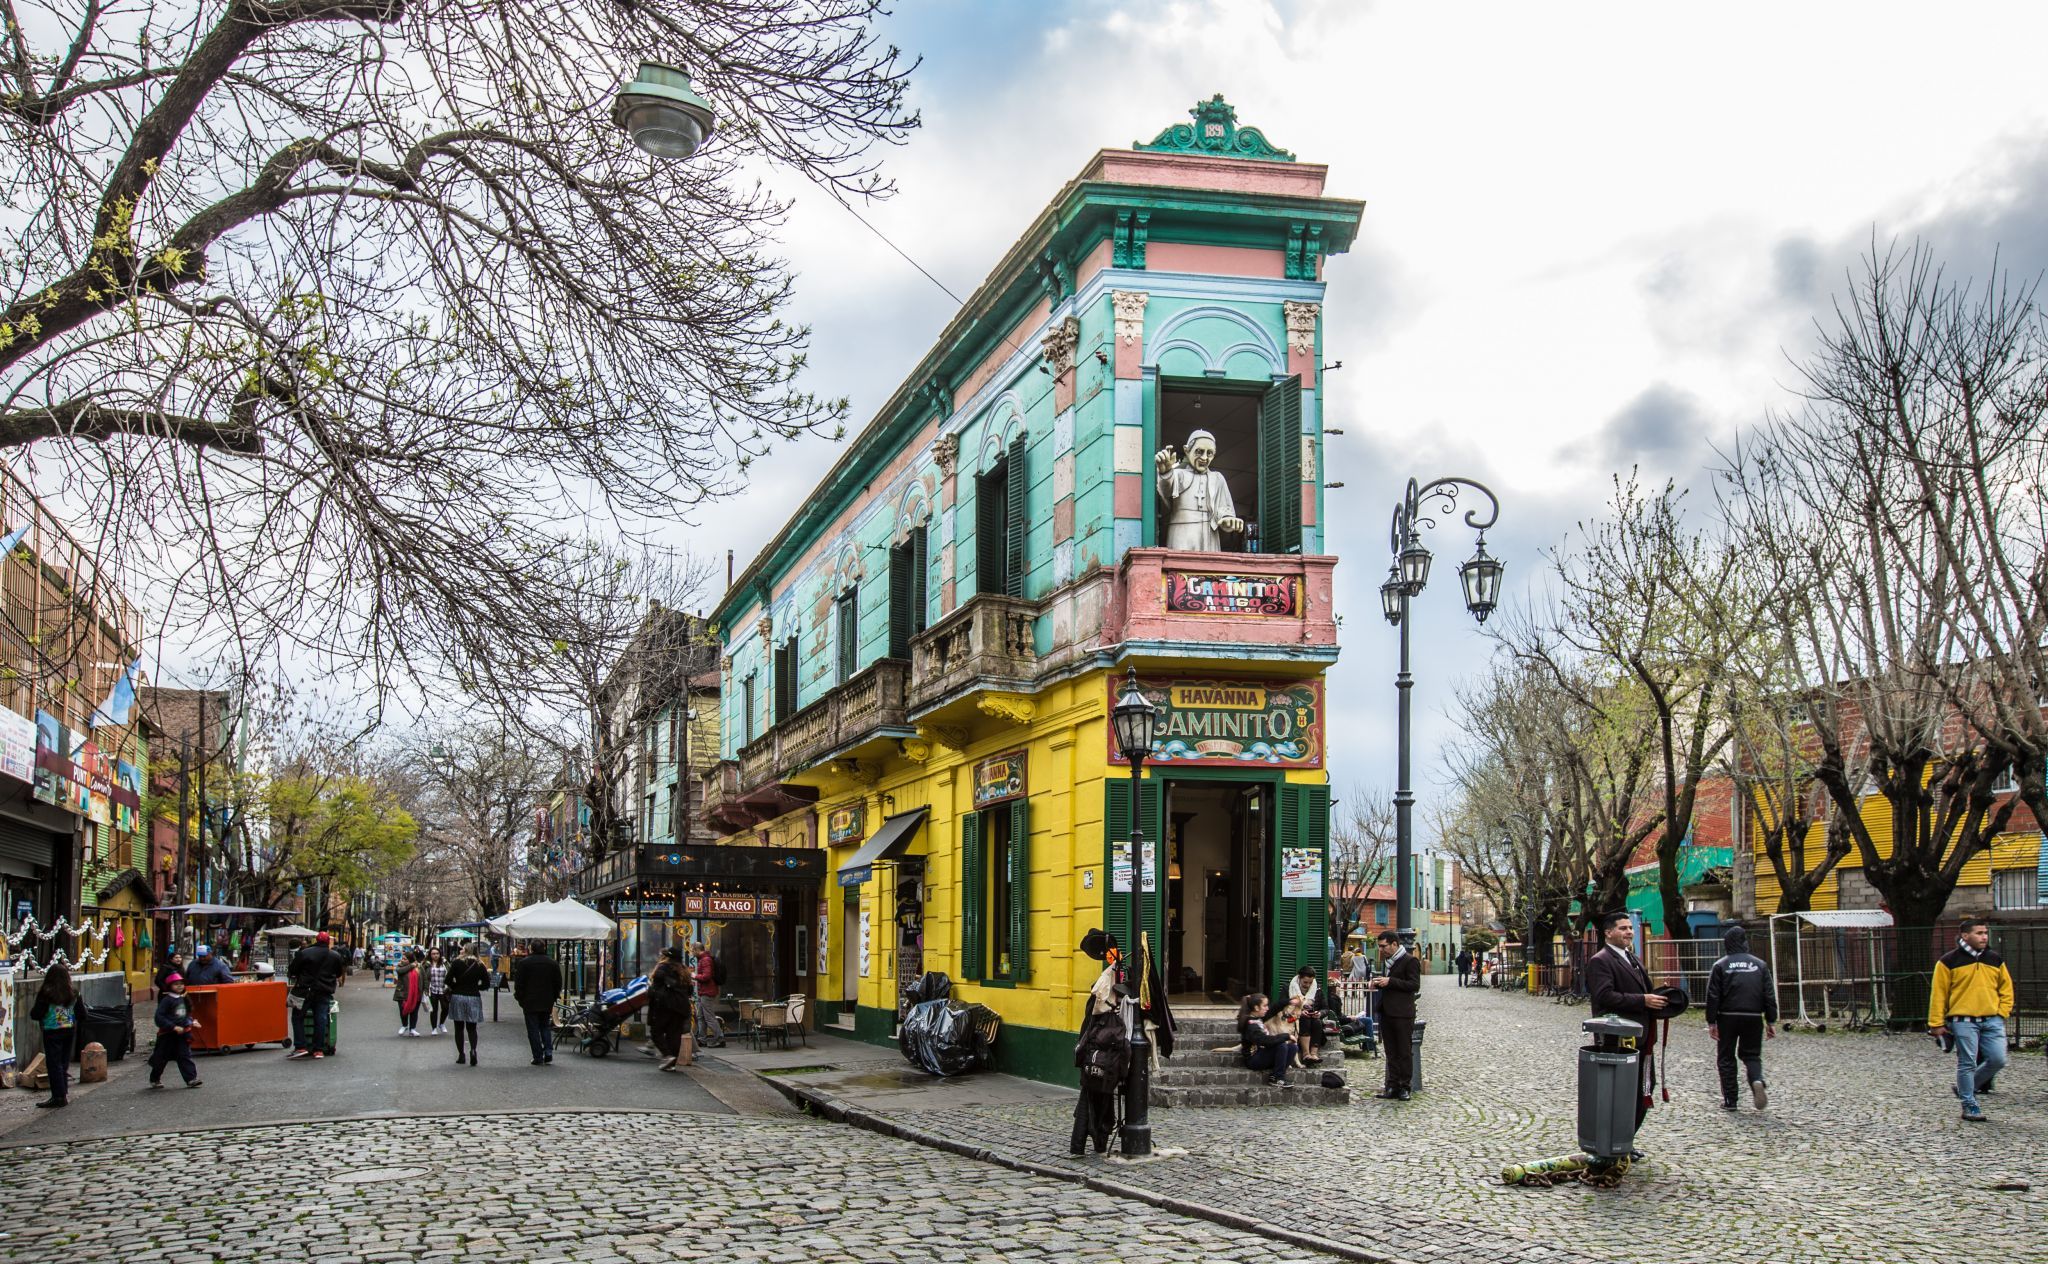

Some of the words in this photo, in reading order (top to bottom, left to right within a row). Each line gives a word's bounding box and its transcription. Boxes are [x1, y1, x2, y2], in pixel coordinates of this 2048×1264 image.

[1205, 124, 1223, 137] 1891
[1189, 577, 1278, 598] CAMINITO
[1206, 595, 1261, 607] AMIGO
[1180, 689, 1259, 706] HAVANNA
[1153, 706, 1292, 739] CAMINITO
[713, 900, 751, 911] TANGO
[763, 902, 777, 912] ARTE
